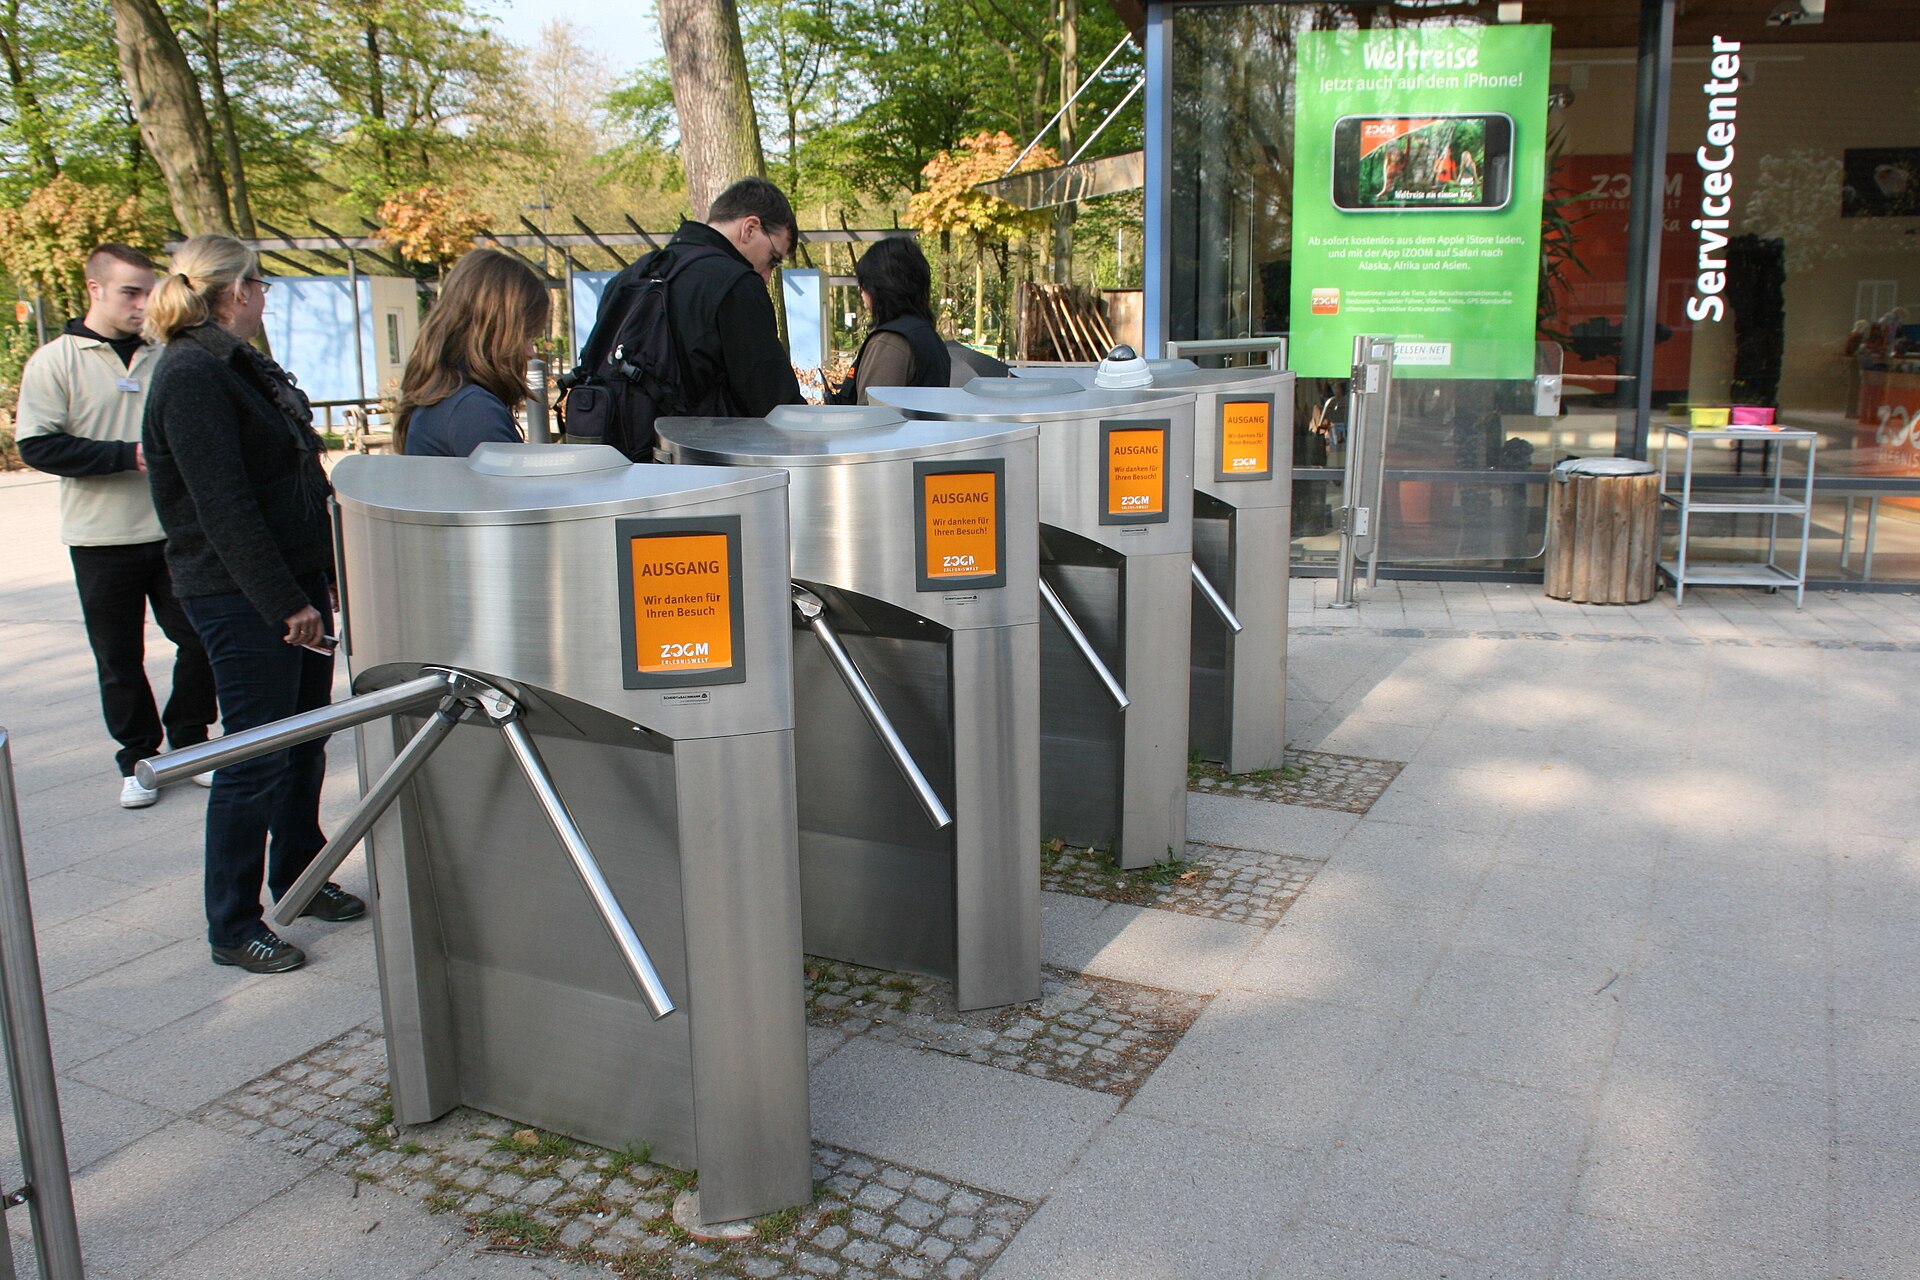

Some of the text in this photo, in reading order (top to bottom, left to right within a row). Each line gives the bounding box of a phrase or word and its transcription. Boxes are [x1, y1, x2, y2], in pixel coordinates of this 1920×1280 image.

[1363, 40, 1479, 70] Weltreise
[1320, 72, 1523, 93] Jetzt auch auf dem iPhone!
[1686, 35, 1742, 322] ServiceCenter
[1308, 234, 1525, 246] Ab sofort kostenlos aus dem Apple iStore laden,
[1328, 247, 1504, 259] und mit der App iZOOM auf Safari nach
[1358, 260, 1471, 271] Alaska, Afrika und Asien.
[1228, 416, 1264, 424] AUSGANG
[1114, 445, 1158, 455] AUSGANG
[932, 492, 989, 504] AUSGANG
[1121, 495, 1150, 505] ZOOM
[932, 516, 989, 526] Wir danken für
[934, 527, 987, 536] Ihren Besuch!
[641, 560, 720, 577] AUSGANG
[643, 592, 721, 606] Wir danken für
[646, 606, 715, 618] Ihren Besuch
[660, 642, 709, 658] ZOOM
